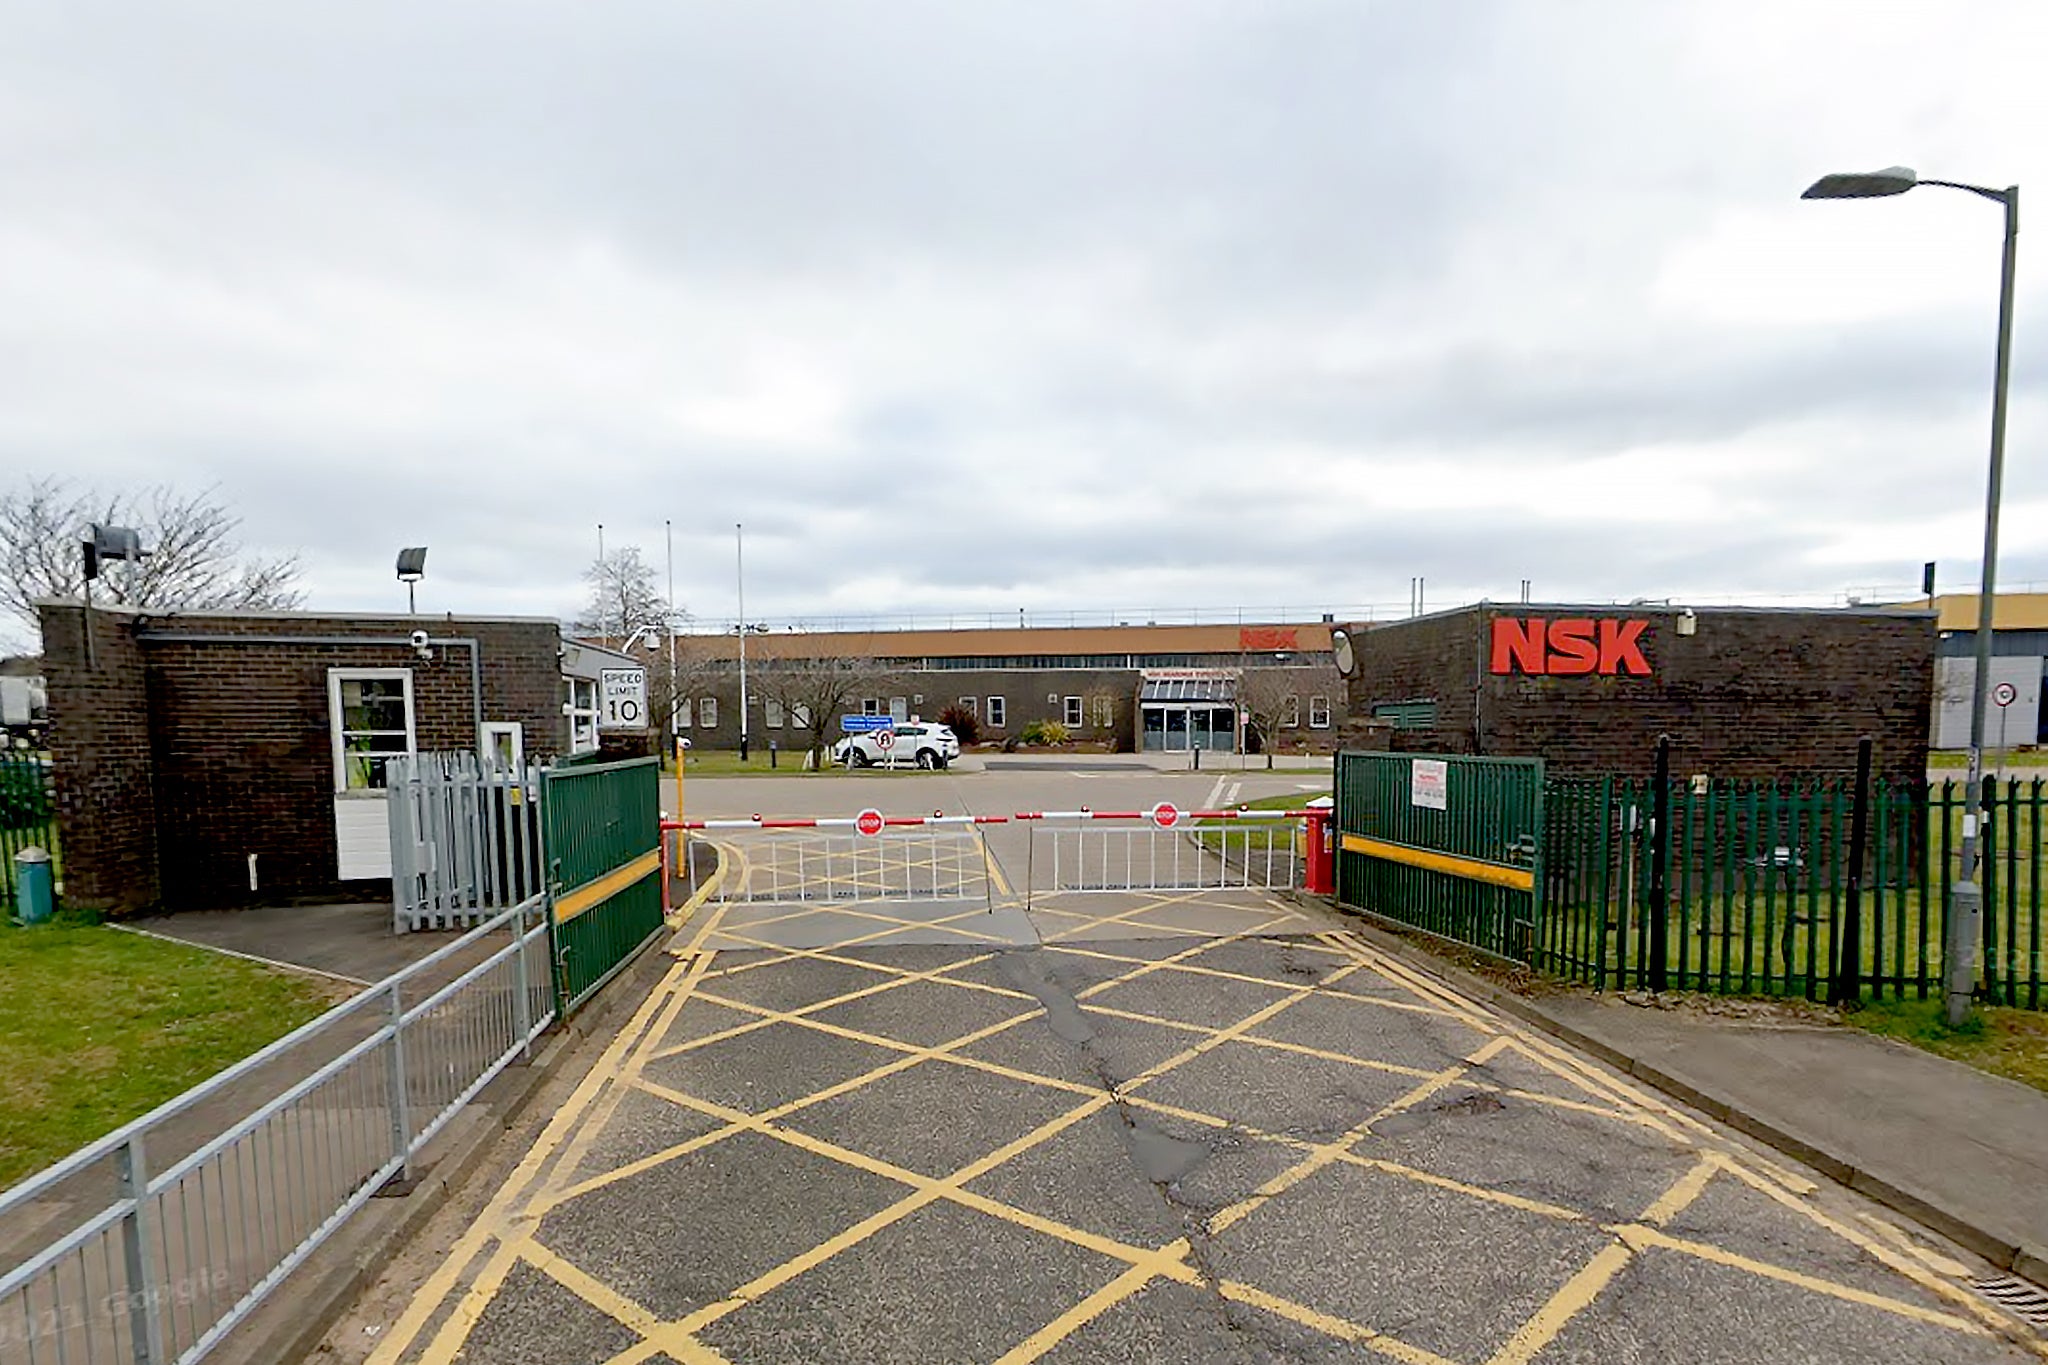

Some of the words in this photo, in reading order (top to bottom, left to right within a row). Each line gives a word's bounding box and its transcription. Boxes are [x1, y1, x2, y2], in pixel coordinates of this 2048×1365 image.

[1240, 627, 1298, 649] NSK
[1490, 616, 1653, 677] NSK
[604, 672, 642, 684] SPEED
[607, 686, 638, 696] LIMIT
[609, 700, 638, 721] 10
[1156, 810, 1176, 819] STOP
[860, 818, 879, 828] STOP
